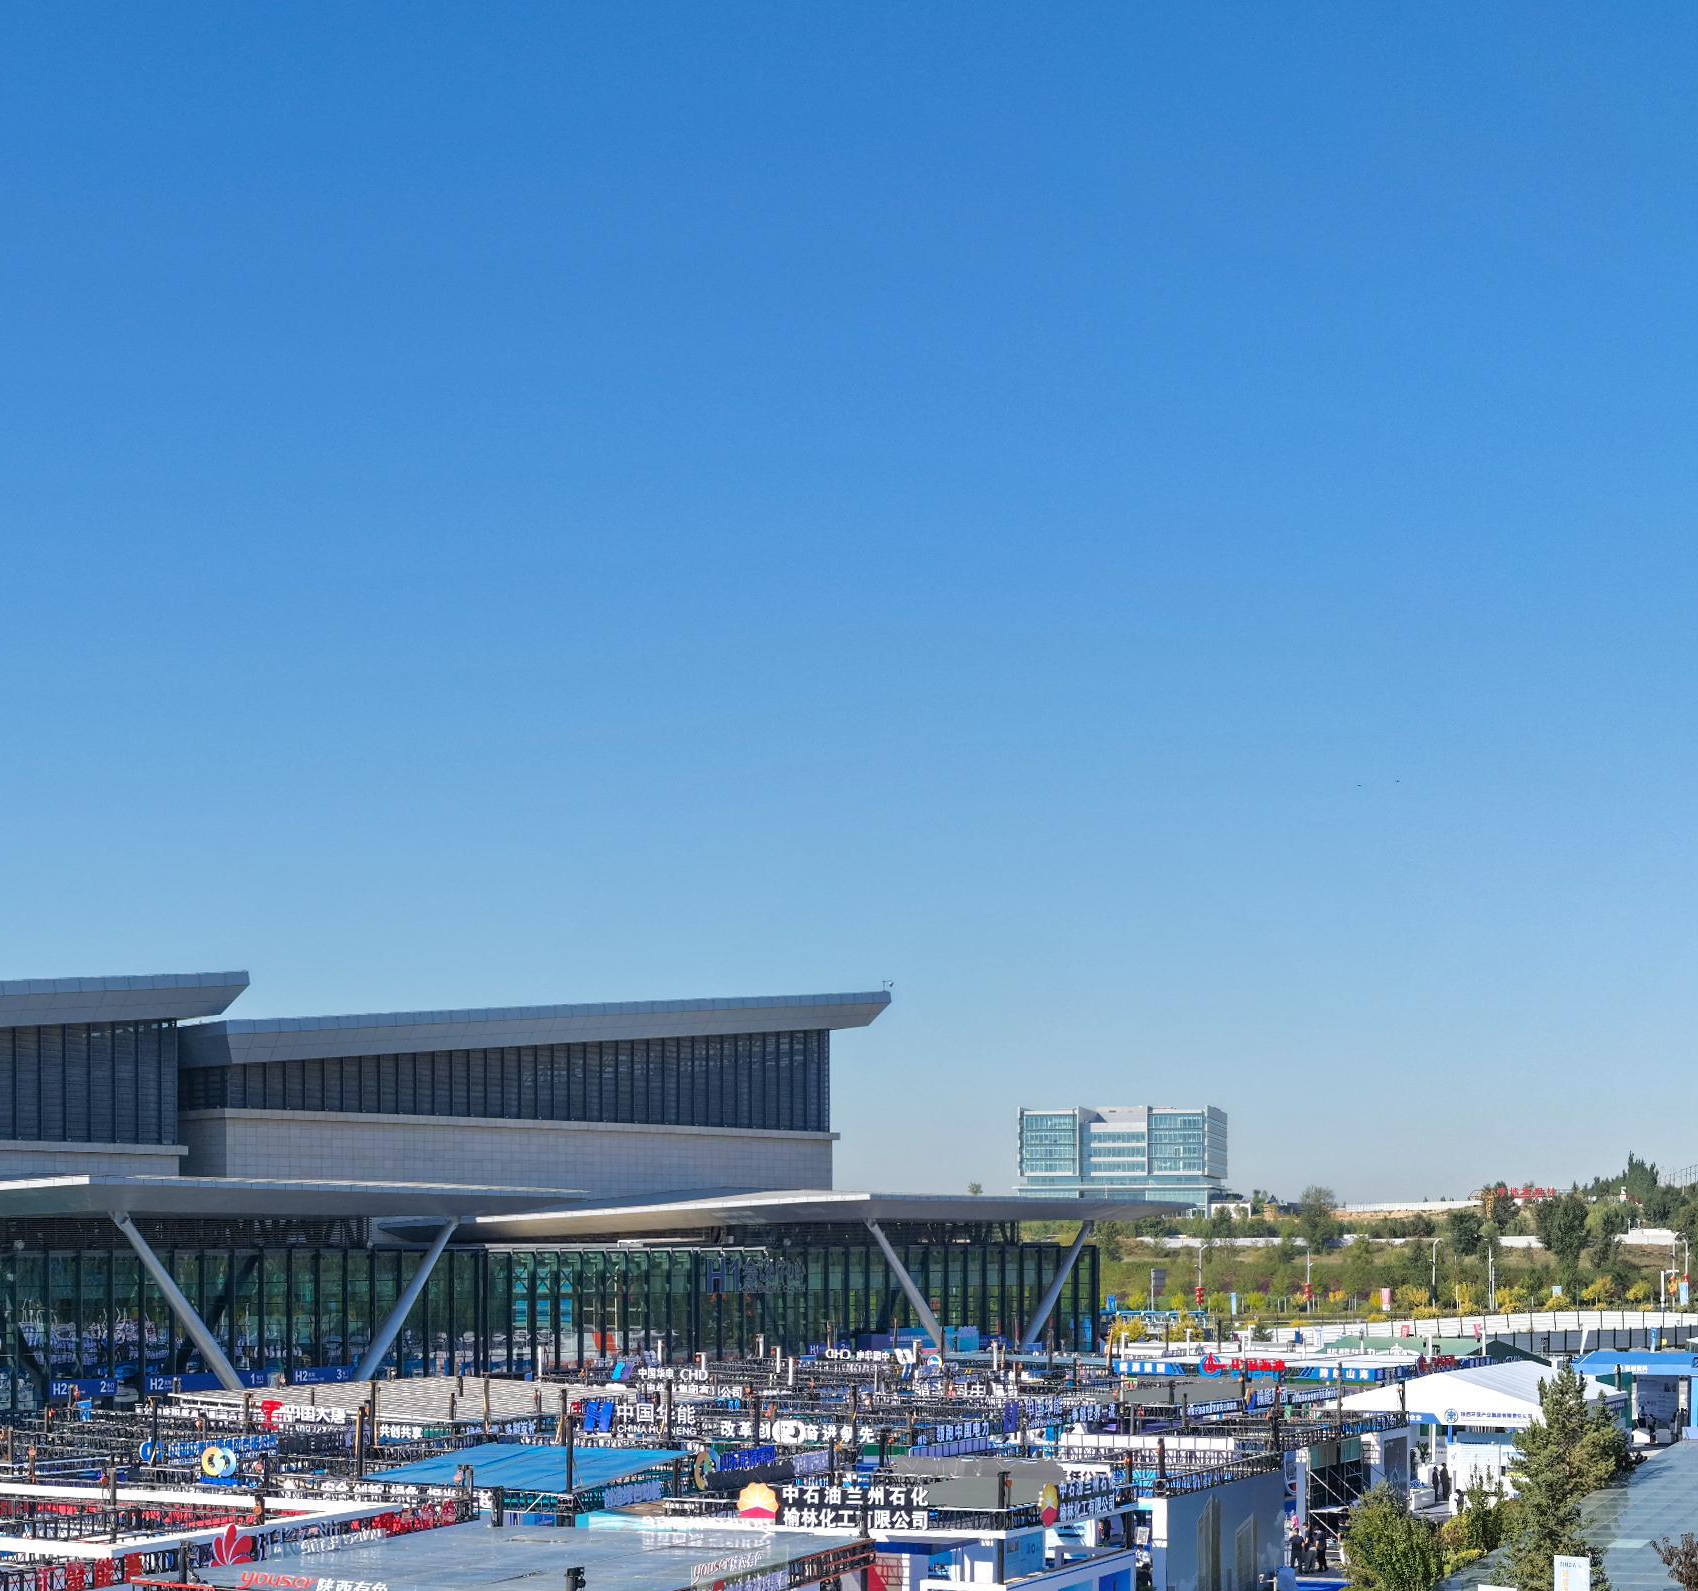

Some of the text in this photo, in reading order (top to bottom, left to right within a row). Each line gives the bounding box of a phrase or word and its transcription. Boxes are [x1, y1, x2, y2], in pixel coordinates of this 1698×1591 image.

[707, 1258, 741, 1294] H1
[295, 1368, 343, 1382] H2 3
[637, 1367, 709, 1381] 中国华电 CHD
[52, 1380, 107, 1395] H2 2
[150, 1378, 165, 1391] H2
[285, 1406, 346, 1424] 中国大唐
[616, 1402, 696, 1425] 中国华能
[379, 1424, 423, 1440] 共创共享
[617, 1424, 645, 1435] CHINA
[782, 1486, 929, 1507] 中石油兰州石化
[783, 1508, 929, 1531] 榆林化工有限公司
